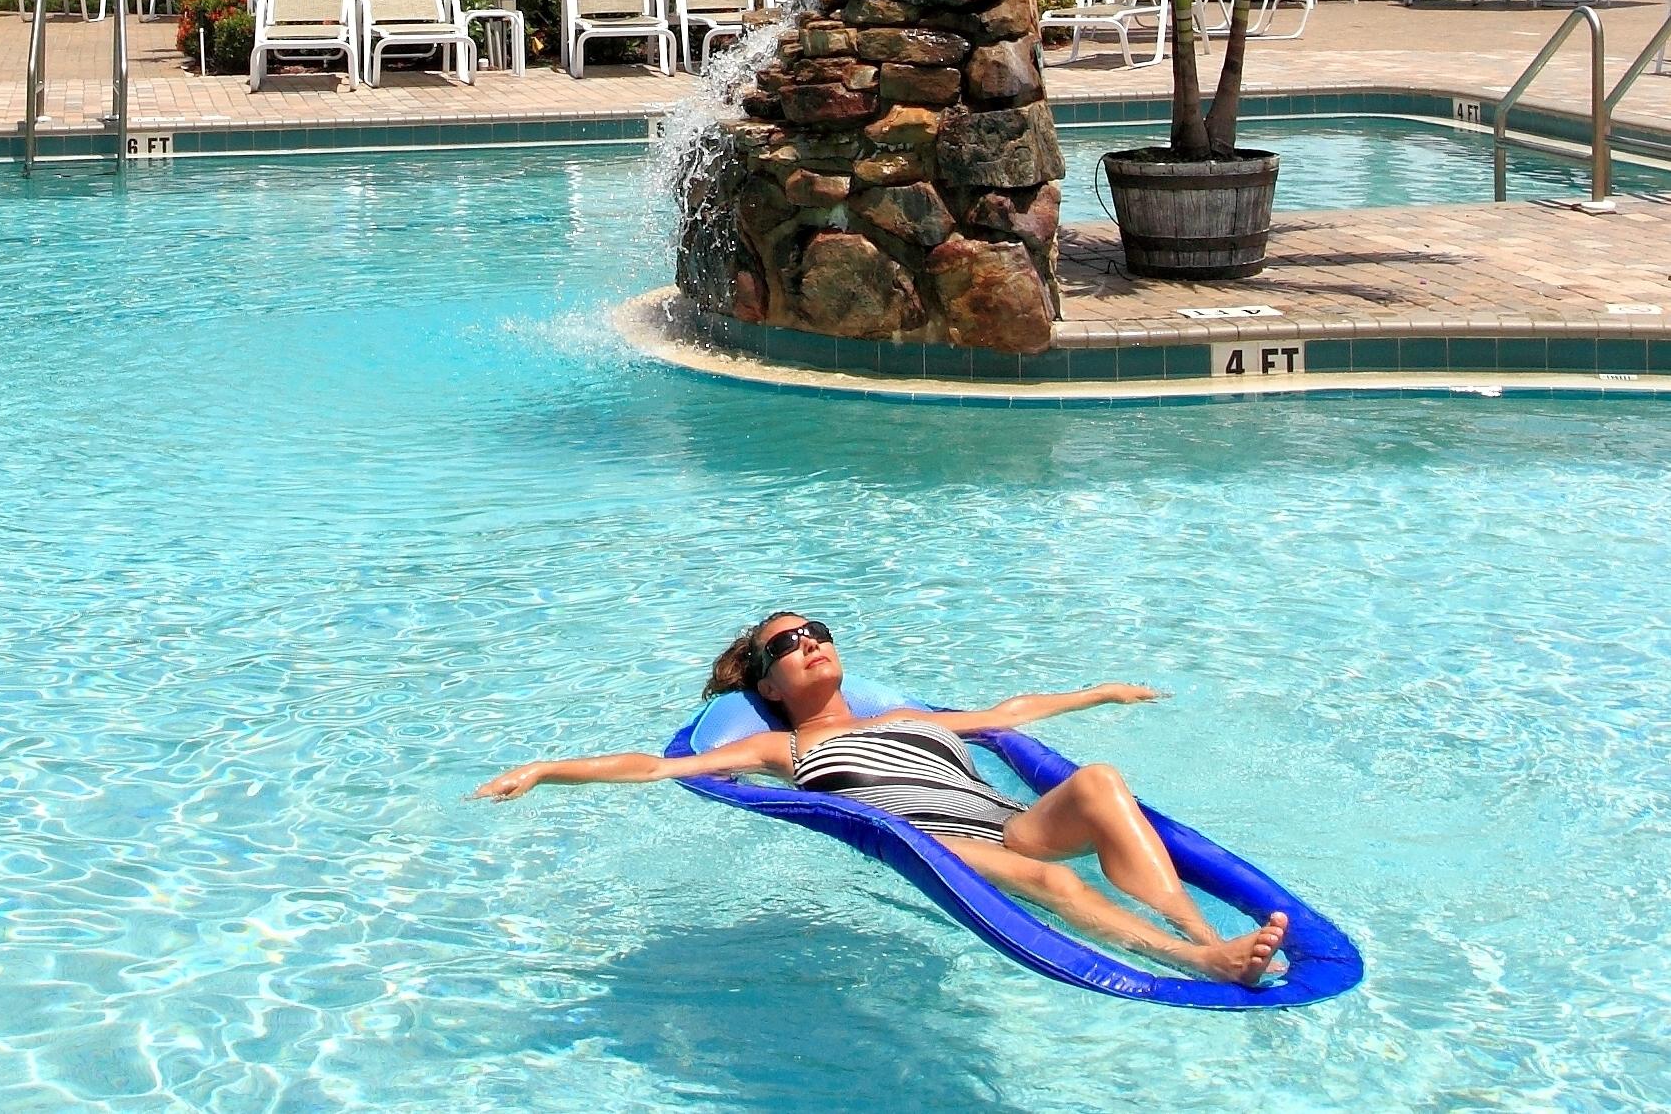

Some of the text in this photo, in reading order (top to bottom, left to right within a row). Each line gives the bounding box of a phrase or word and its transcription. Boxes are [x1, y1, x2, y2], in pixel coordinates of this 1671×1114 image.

[1458, 103, 1478, 122] 4 FT
[128, 137, 170, 154] 6 FT
[1225, 347, 1299, 374] 4 FT
